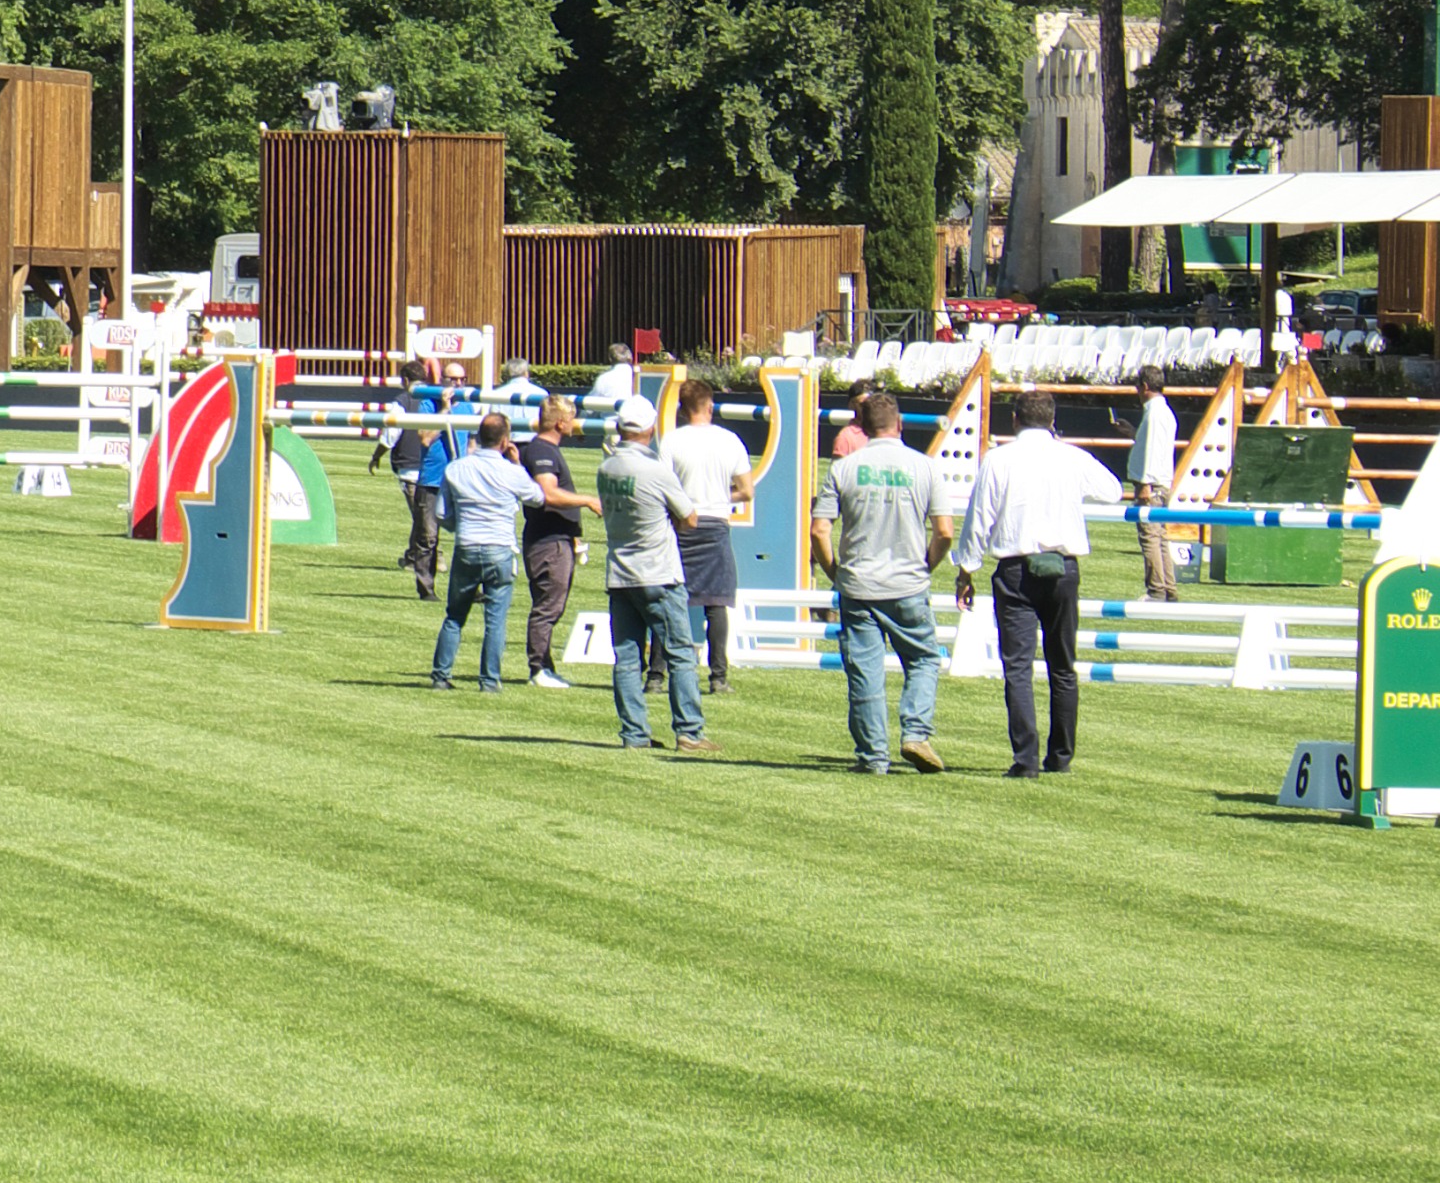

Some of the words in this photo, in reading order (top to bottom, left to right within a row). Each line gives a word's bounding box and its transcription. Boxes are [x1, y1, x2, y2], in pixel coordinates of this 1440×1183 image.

[435, 333, 460, 351] RDS
[1386, 613, 1440, 630] ROLE
[583, 622, 596, 656] 7
[1383, 691, 1440, 710] DEPAR
[1294, 751, 1312, 799] 6
[1335, 752, 1354, 801] 6
